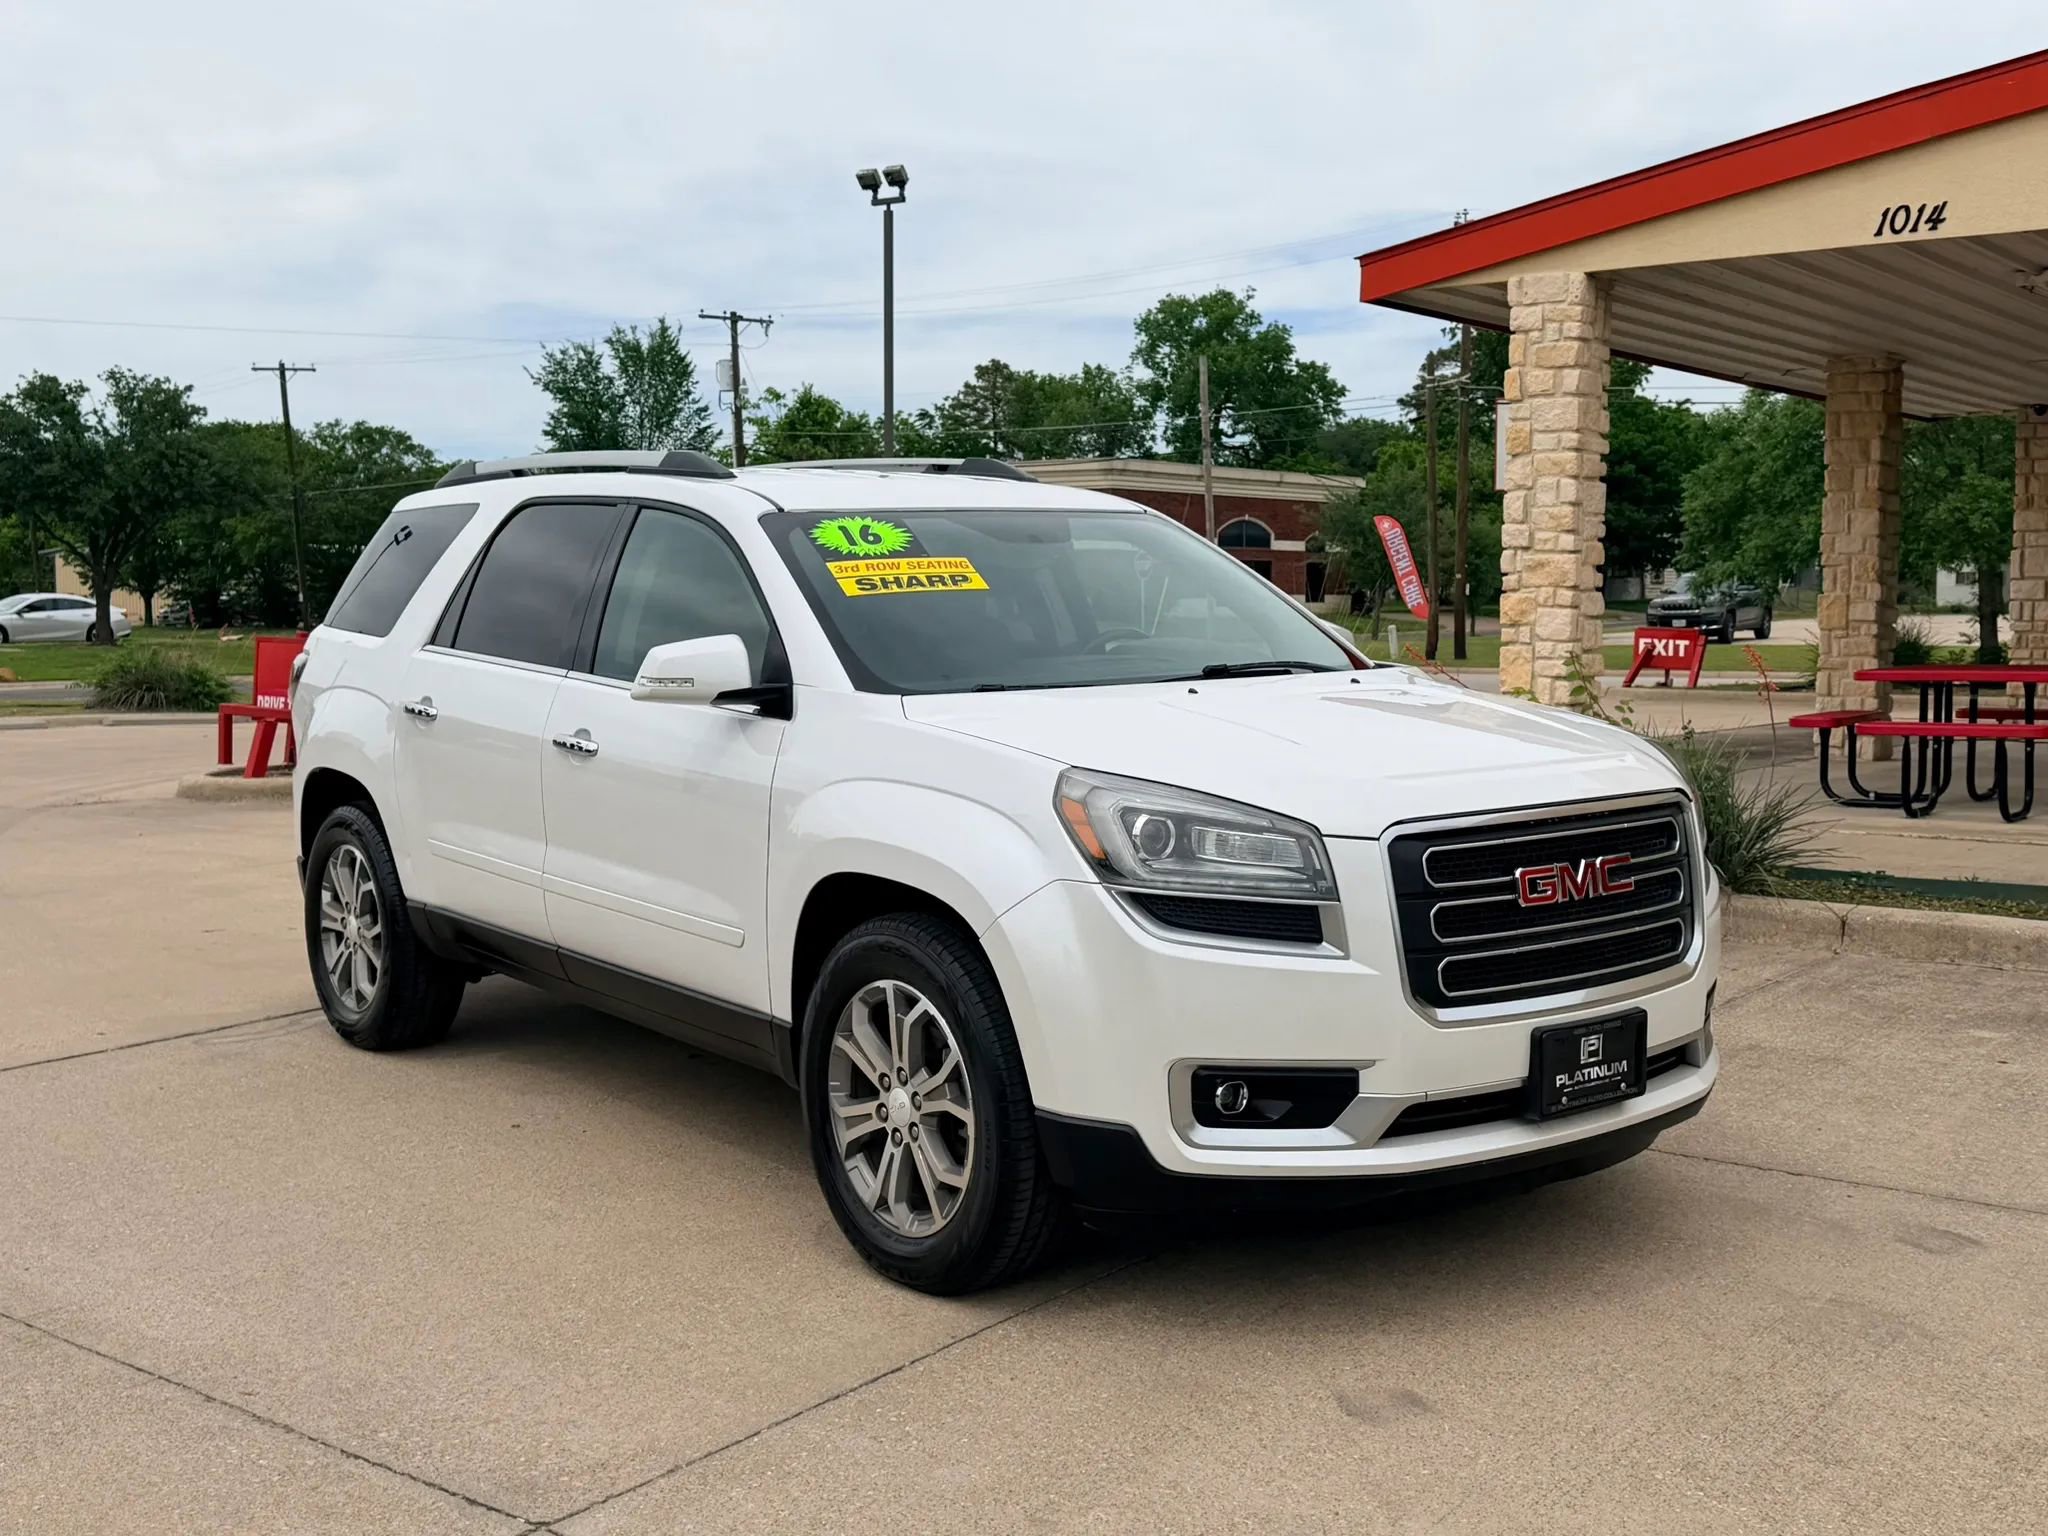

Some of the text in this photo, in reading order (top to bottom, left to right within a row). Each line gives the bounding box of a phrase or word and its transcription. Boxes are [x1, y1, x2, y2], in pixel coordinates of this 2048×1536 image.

[1873, 200, 1949, 237] 1014
[837, 524, 884, 547] 16
[834, 560, 969, 574] 3rd ROW SEATING
[855, 575, 971, 591] SHARP
[1639, 638, 1690, 657] EXIT
[257, 695, 285, 709] DRIVE
[1515, 852, 1635, 907] GMC
[1555, 1059, 1628, 1088] PLATINUM
